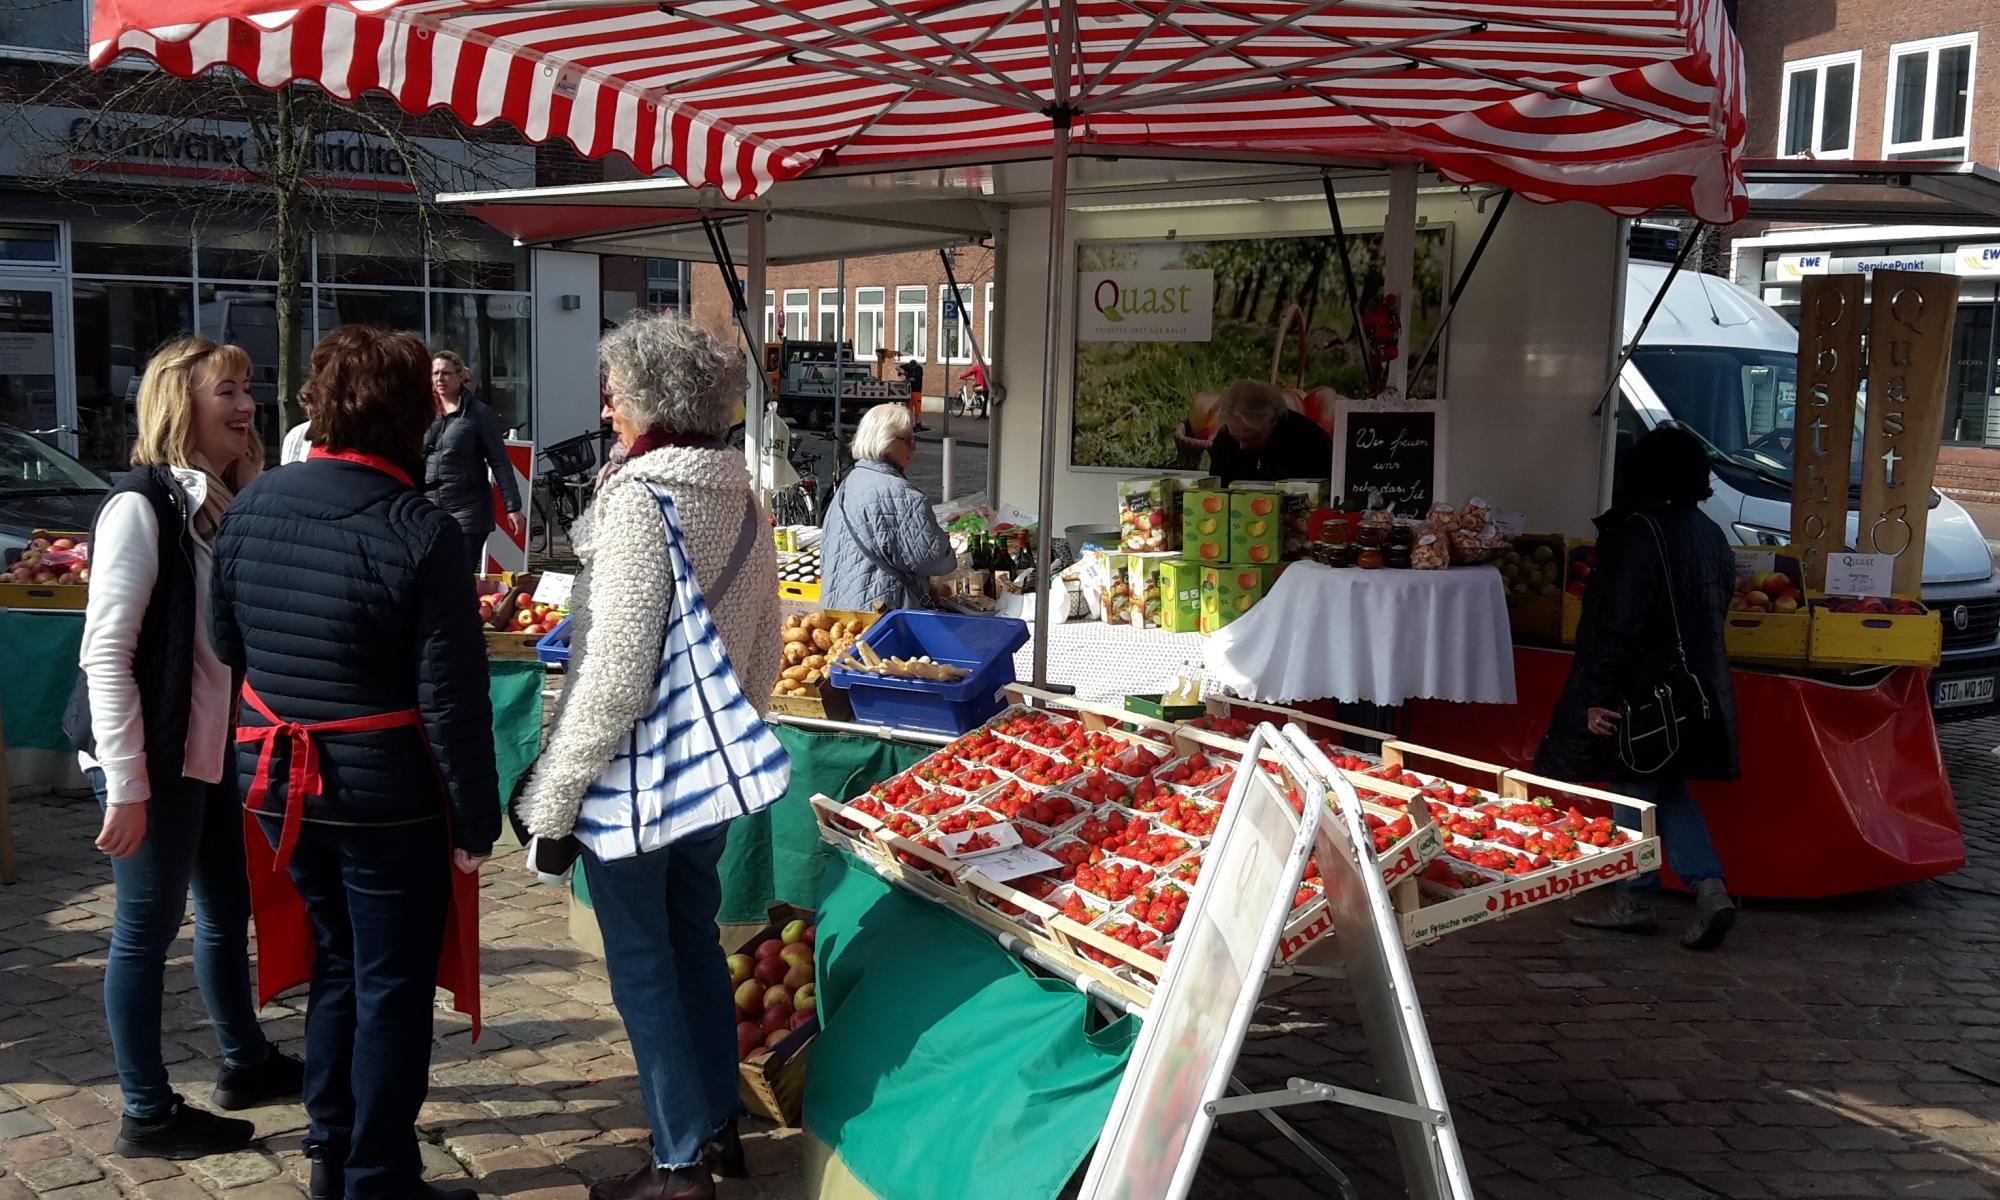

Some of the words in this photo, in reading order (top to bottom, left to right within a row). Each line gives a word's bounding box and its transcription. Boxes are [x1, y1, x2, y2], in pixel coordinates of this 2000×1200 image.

[1800, 256, 1820, 267] EWE
[1982, 248, 2000, 260] EW
[1857, 260, 1924, 272] ServicePunkt
[1094, 279, 1192, 322] Quast
[1880, 287, 1923, 489] Quast
[1356, 427, 1385, 448] Wir
[1372, 461, 1400, 470] uns
[1843, 555, 1875, 568] Quast
[1940, 683, 1958, 701] STD
[1978, 679, 1993, 697] 107
[1500, 851, 1637, 913] hubired
[1415, 928, 1428, 938] der
[1430, 918, 1460, 934] Frische
[1461, 910, 1488, 924] wegen
